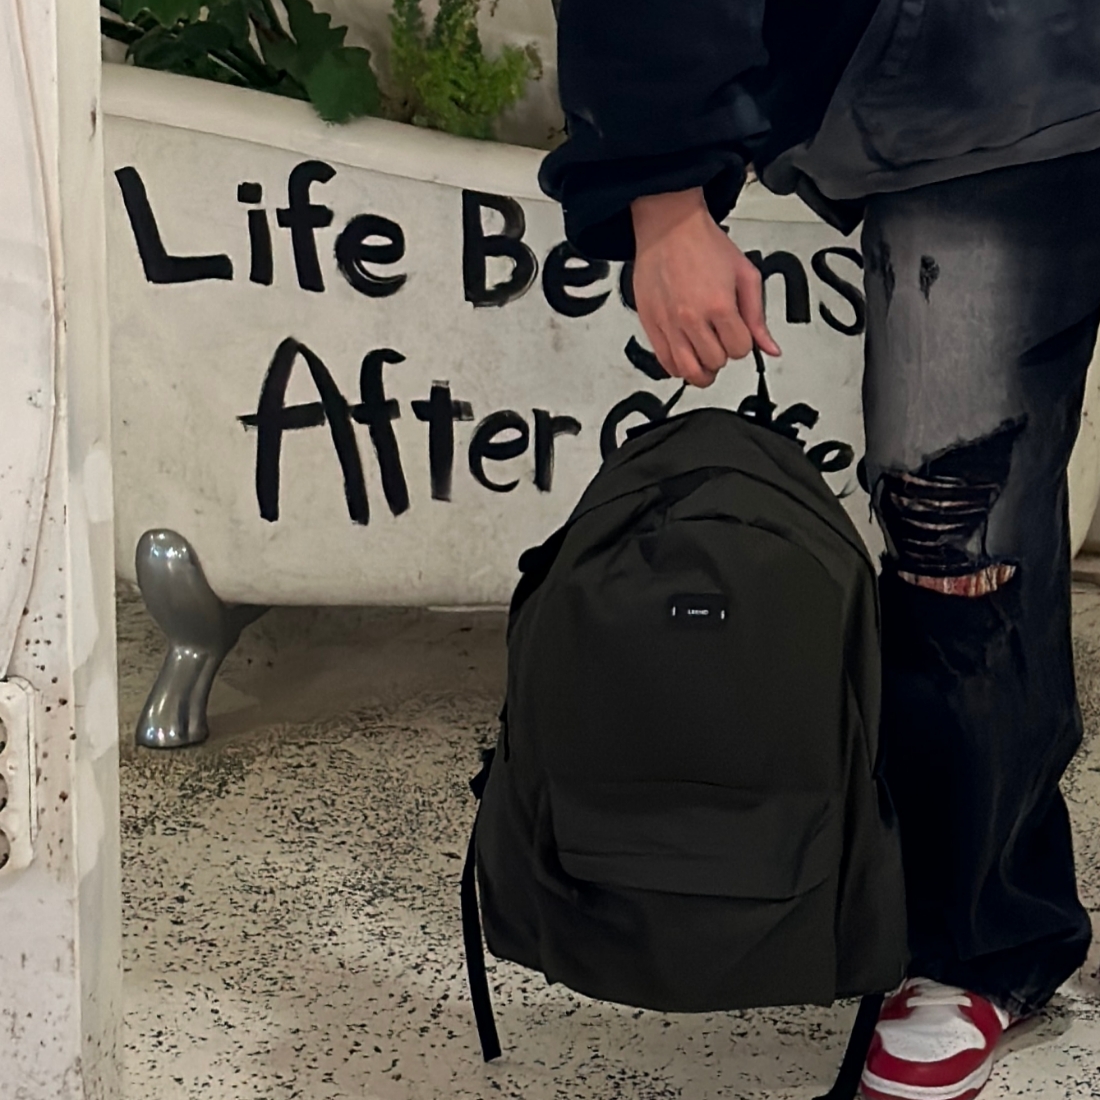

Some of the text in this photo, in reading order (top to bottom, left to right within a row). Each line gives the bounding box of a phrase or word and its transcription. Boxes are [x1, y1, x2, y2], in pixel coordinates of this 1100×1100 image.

[114, 159, 866, 380] Life Bens
[236, 336, 582, 526] After
